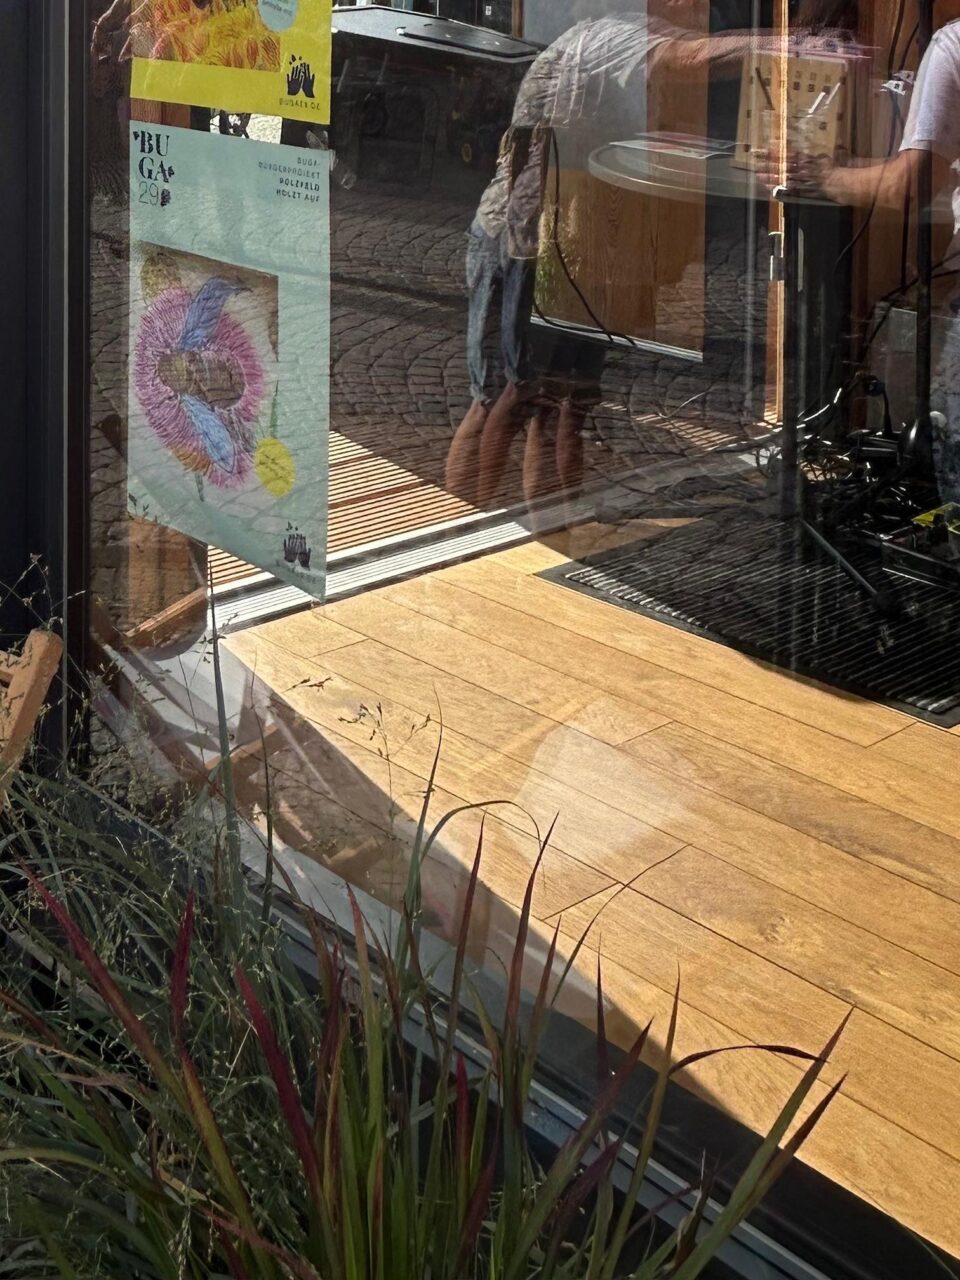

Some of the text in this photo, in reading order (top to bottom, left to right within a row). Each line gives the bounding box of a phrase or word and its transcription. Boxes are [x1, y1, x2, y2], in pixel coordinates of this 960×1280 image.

[139, 130, 170, 157] BU
[138, 156, 170, 183] GA
[138, 181, 159, 206] 29
